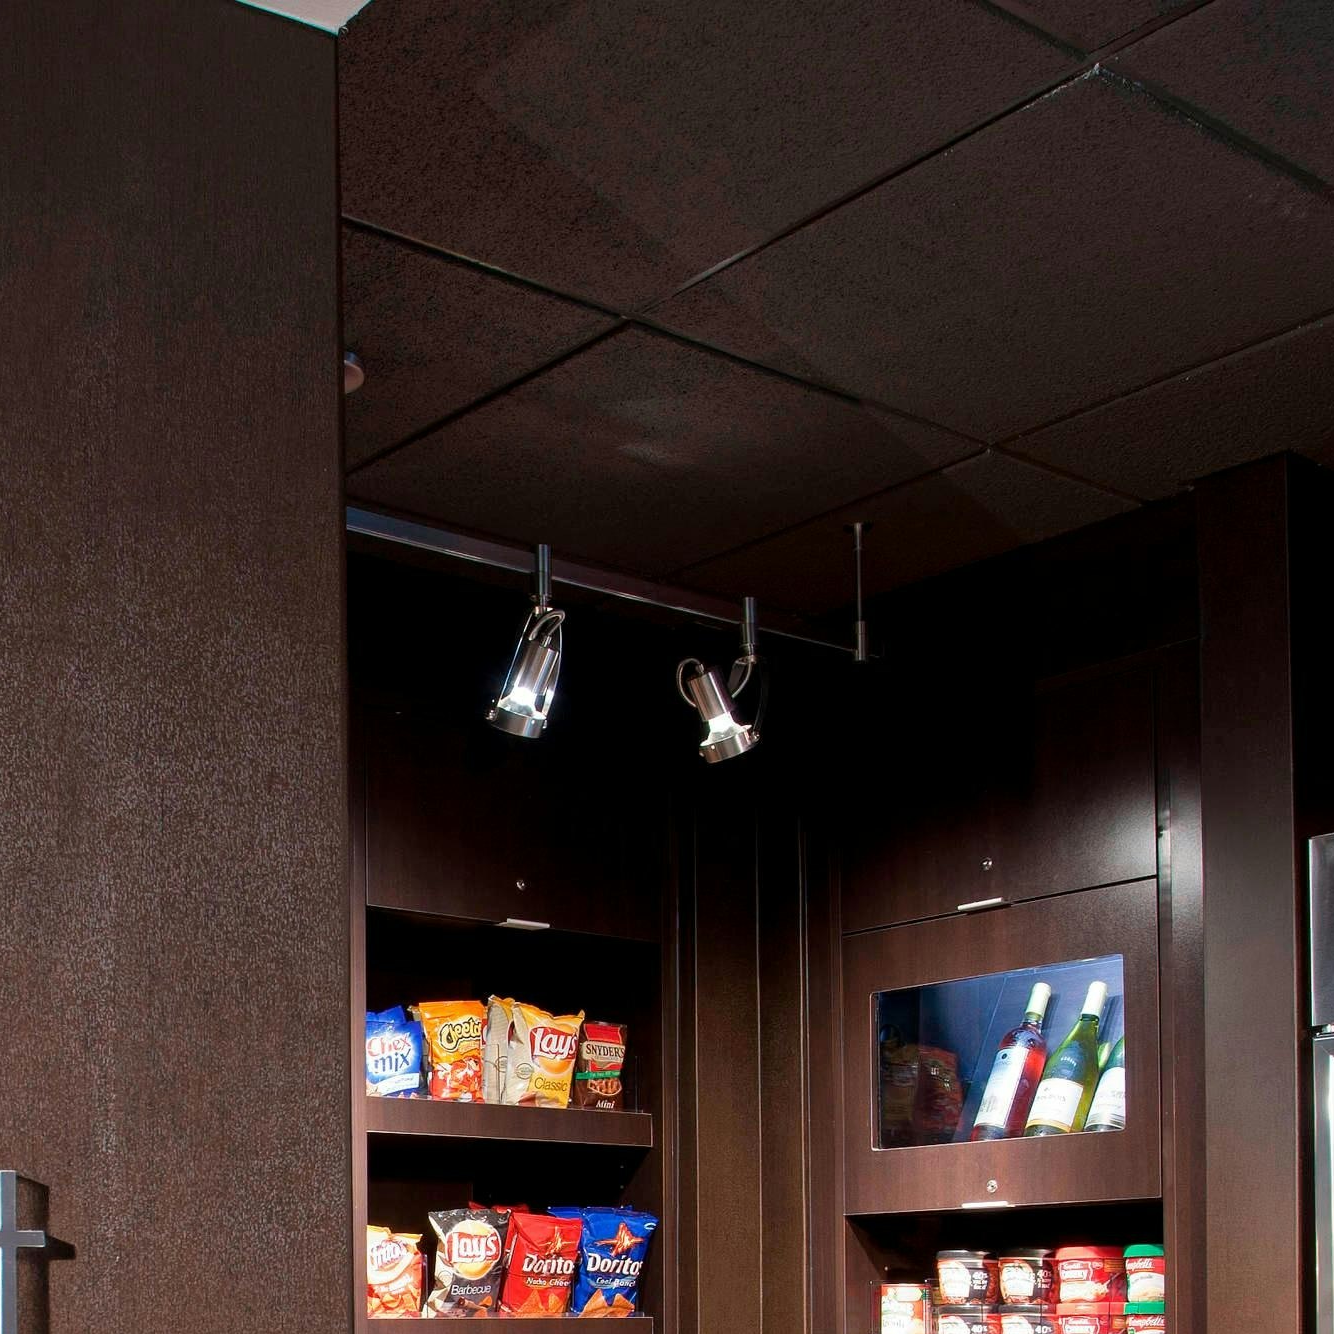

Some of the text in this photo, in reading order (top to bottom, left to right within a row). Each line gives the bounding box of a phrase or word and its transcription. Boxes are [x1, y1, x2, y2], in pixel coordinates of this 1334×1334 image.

[367, 1031, 412, 1058] Chex
[586, 1043, 626, 1059] SNYDER'S
[534, 1076, 568, 1092] Classic
[523, 1252, 574, 1274] Dorito
[451, 1284, 492, 1296] Barbecue
